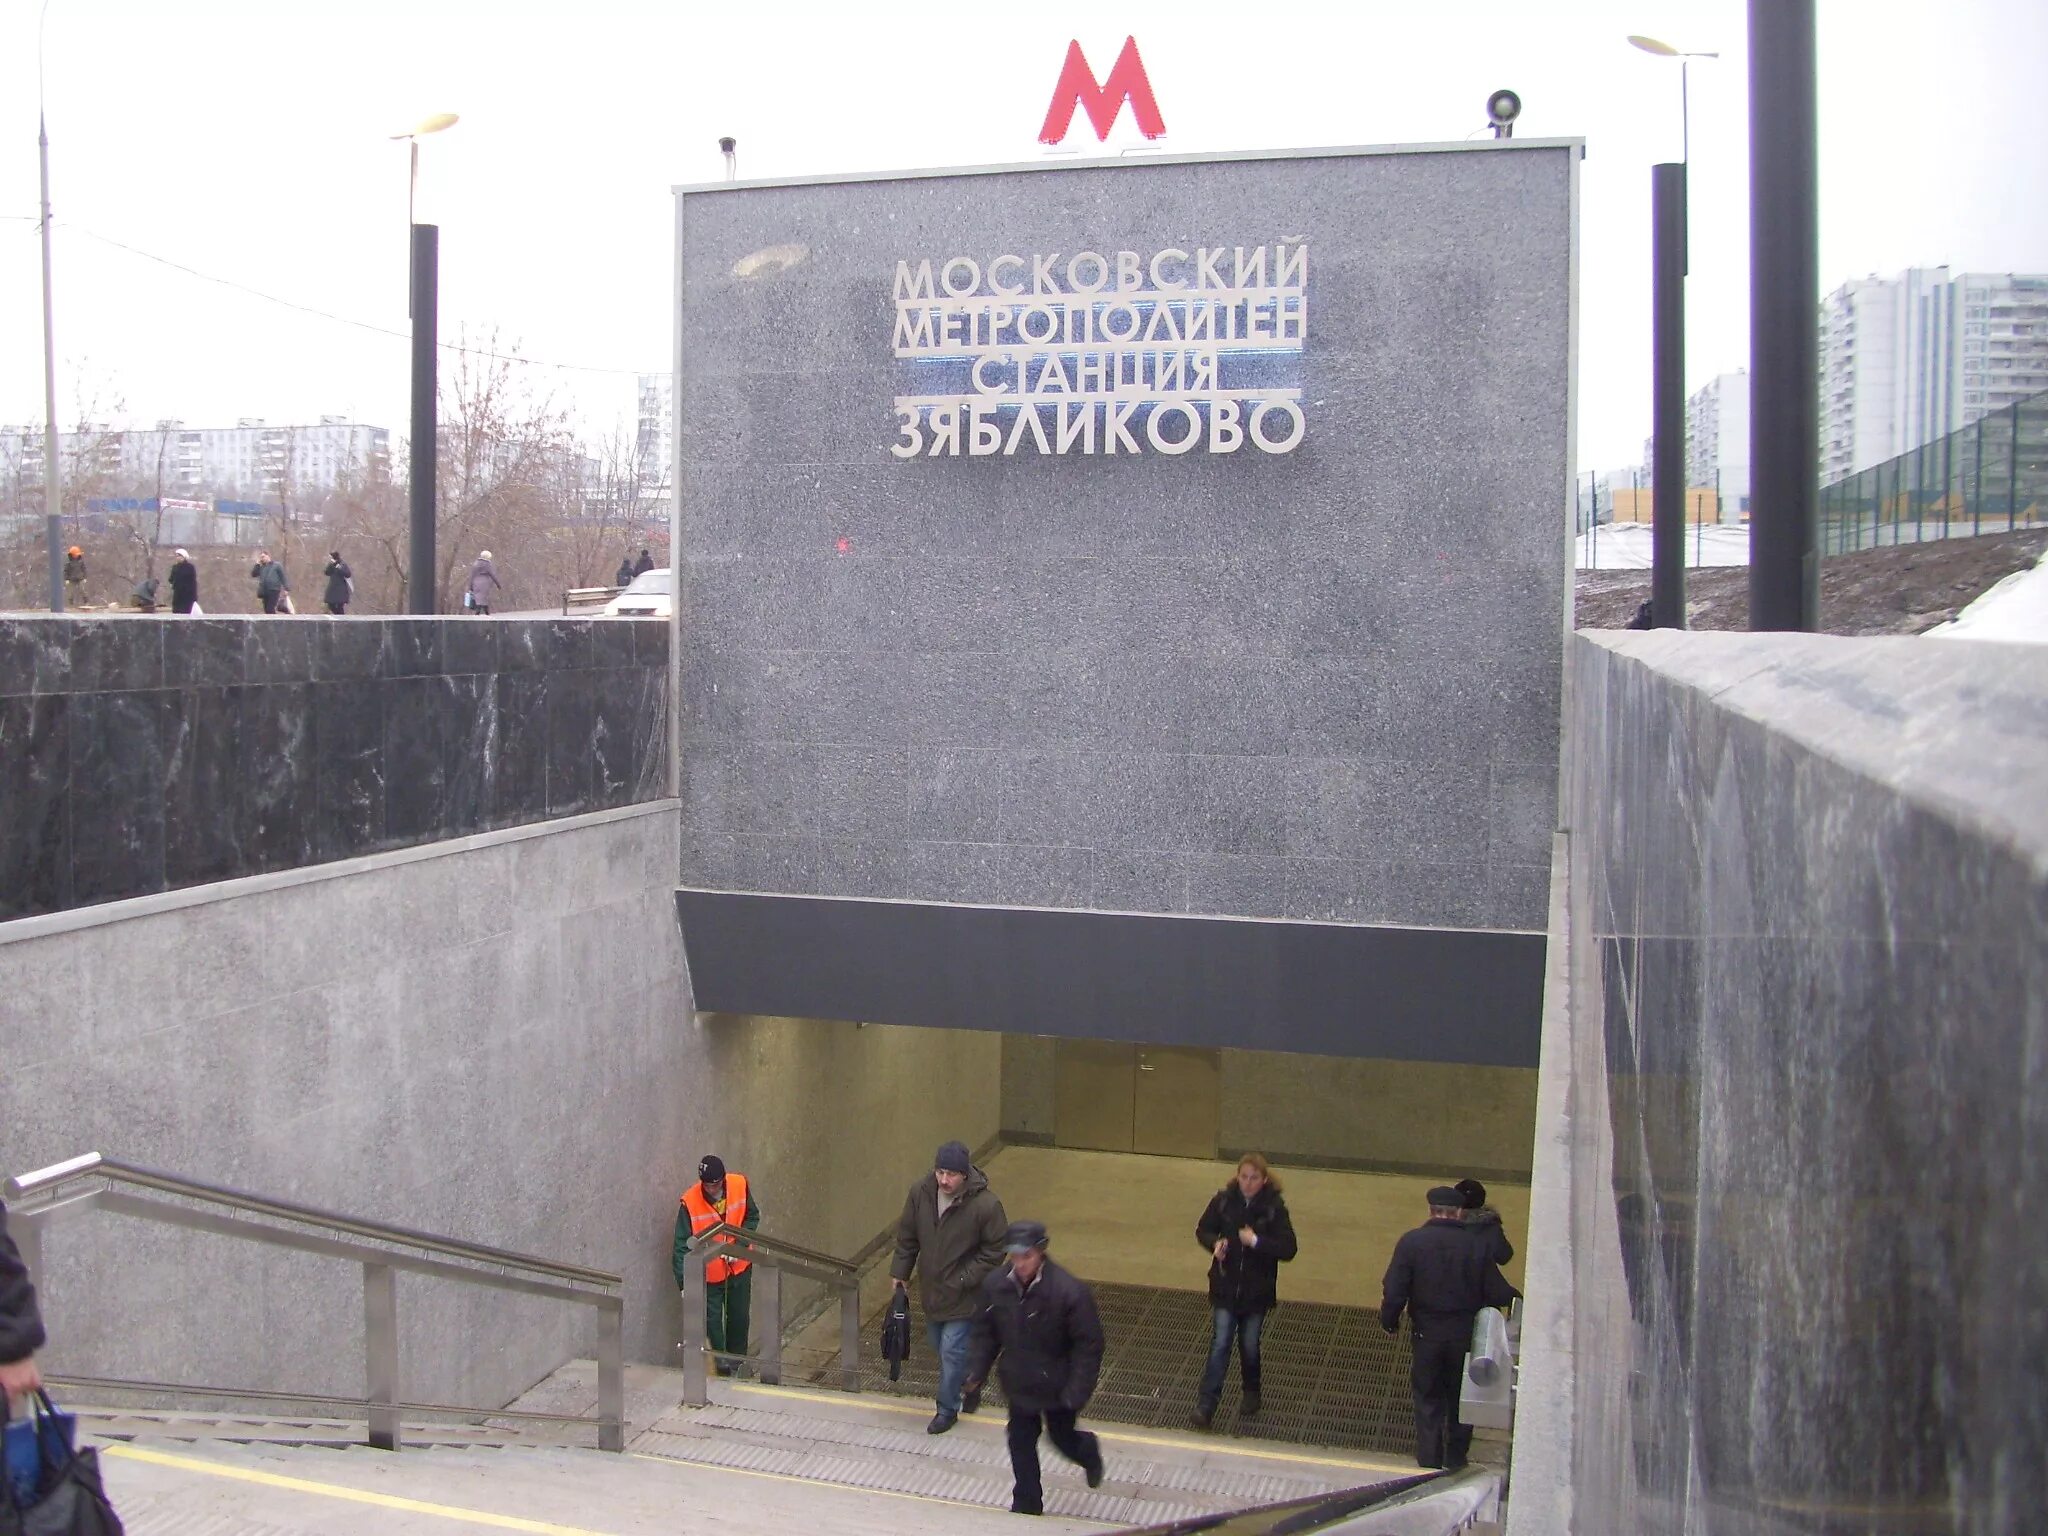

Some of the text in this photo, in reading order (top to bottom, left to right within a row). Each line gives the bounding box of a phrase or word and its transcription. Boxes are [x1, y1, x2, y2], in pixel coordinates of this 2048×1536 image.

[892, 234, 1308, 300] МОСКОВСКИЙ
[892, 296, 1307, 351] МЕТРОПОЛИТЕН
[971, 346, 1218, 397] СТАНЦИЯ
[890, 397, 1306, 458] ЗЯБЛИКОВО
